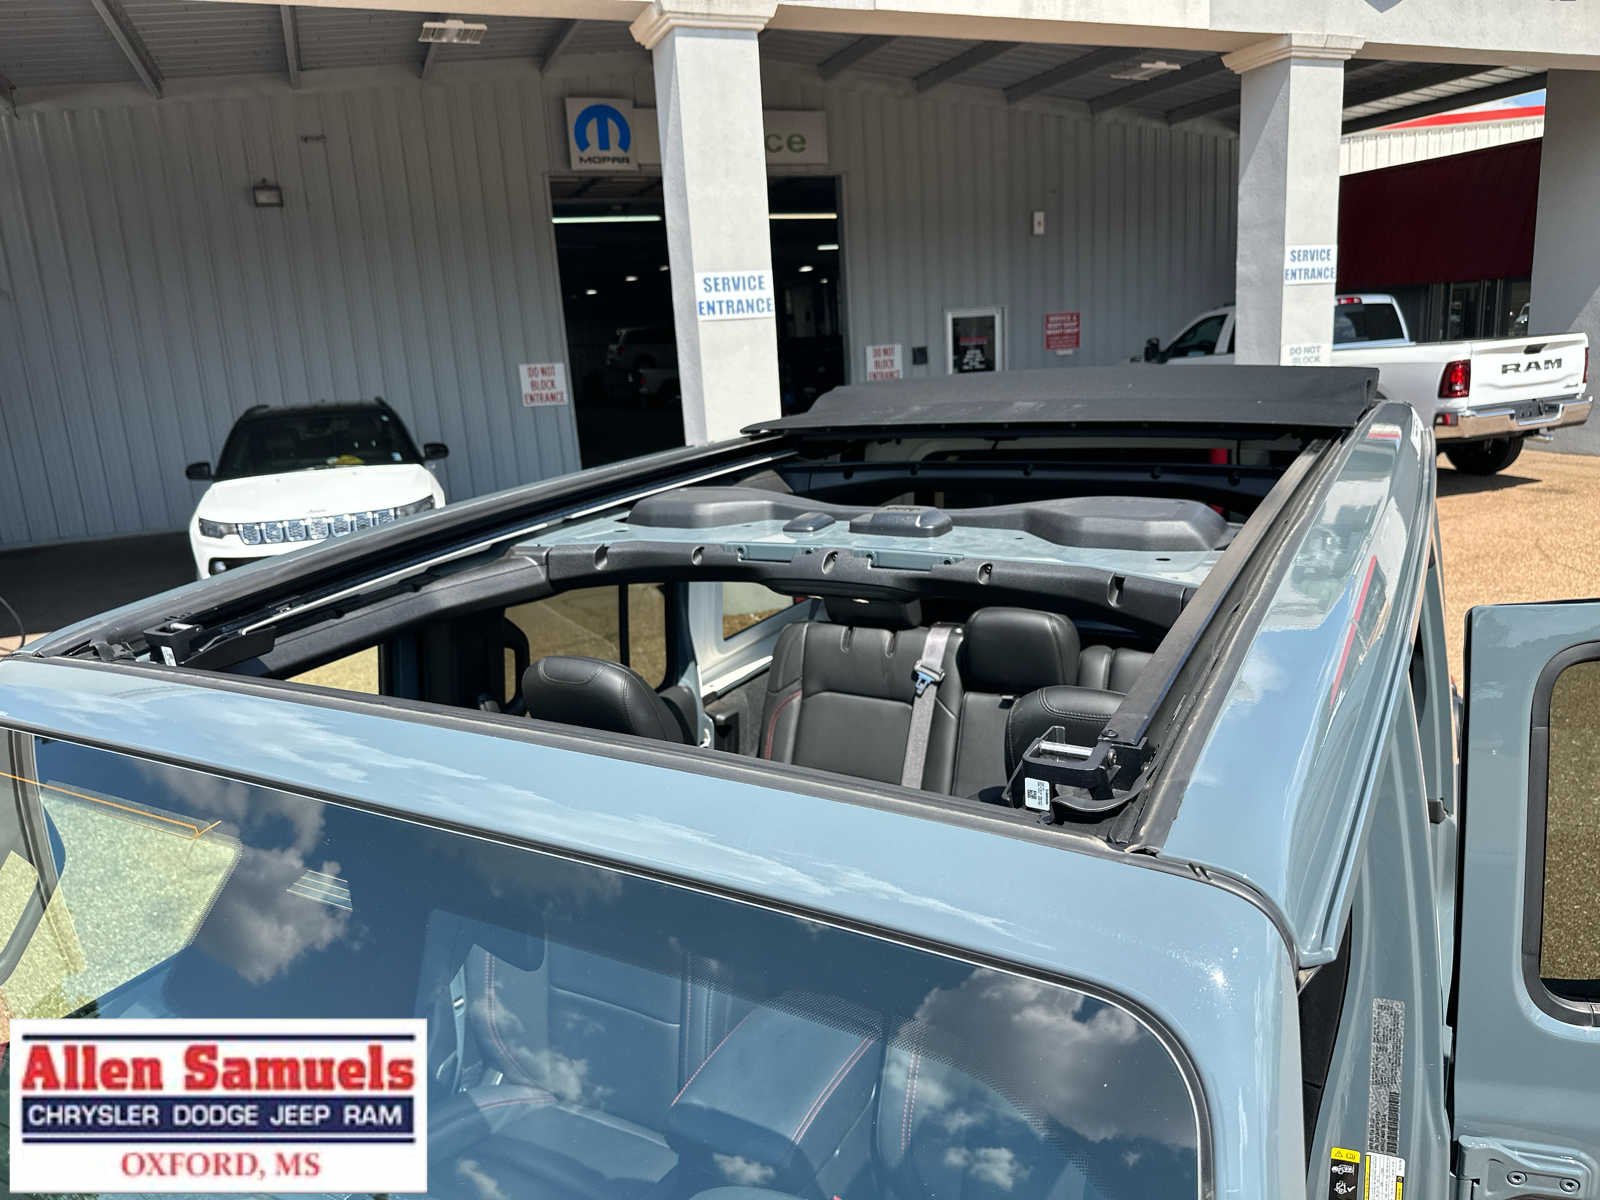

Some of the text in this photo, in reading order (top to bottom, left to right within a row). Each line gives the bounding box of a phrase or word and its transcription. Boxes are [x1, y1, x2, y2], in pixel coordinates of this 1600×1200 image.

[579, 156, 630, 165] MOPAR
[1290, 248, 1332, 262] SERVICE
[1284, 267, 1336, 281] ENTRANCE
[703, 275, 766, 293] SERVICE
[698, 298, 774, 316] ENTRANCE
[1289, 345, 1322, 356] DO NOT
[873, 359, 895, 369] BLOCK
[1501, 358, 1562, 375] RAM
[527, 365, 556, 378] DO NOT
[530, 379, 556, 391] BLOCK
[524, 391, 566, 405] ENTRANCE
